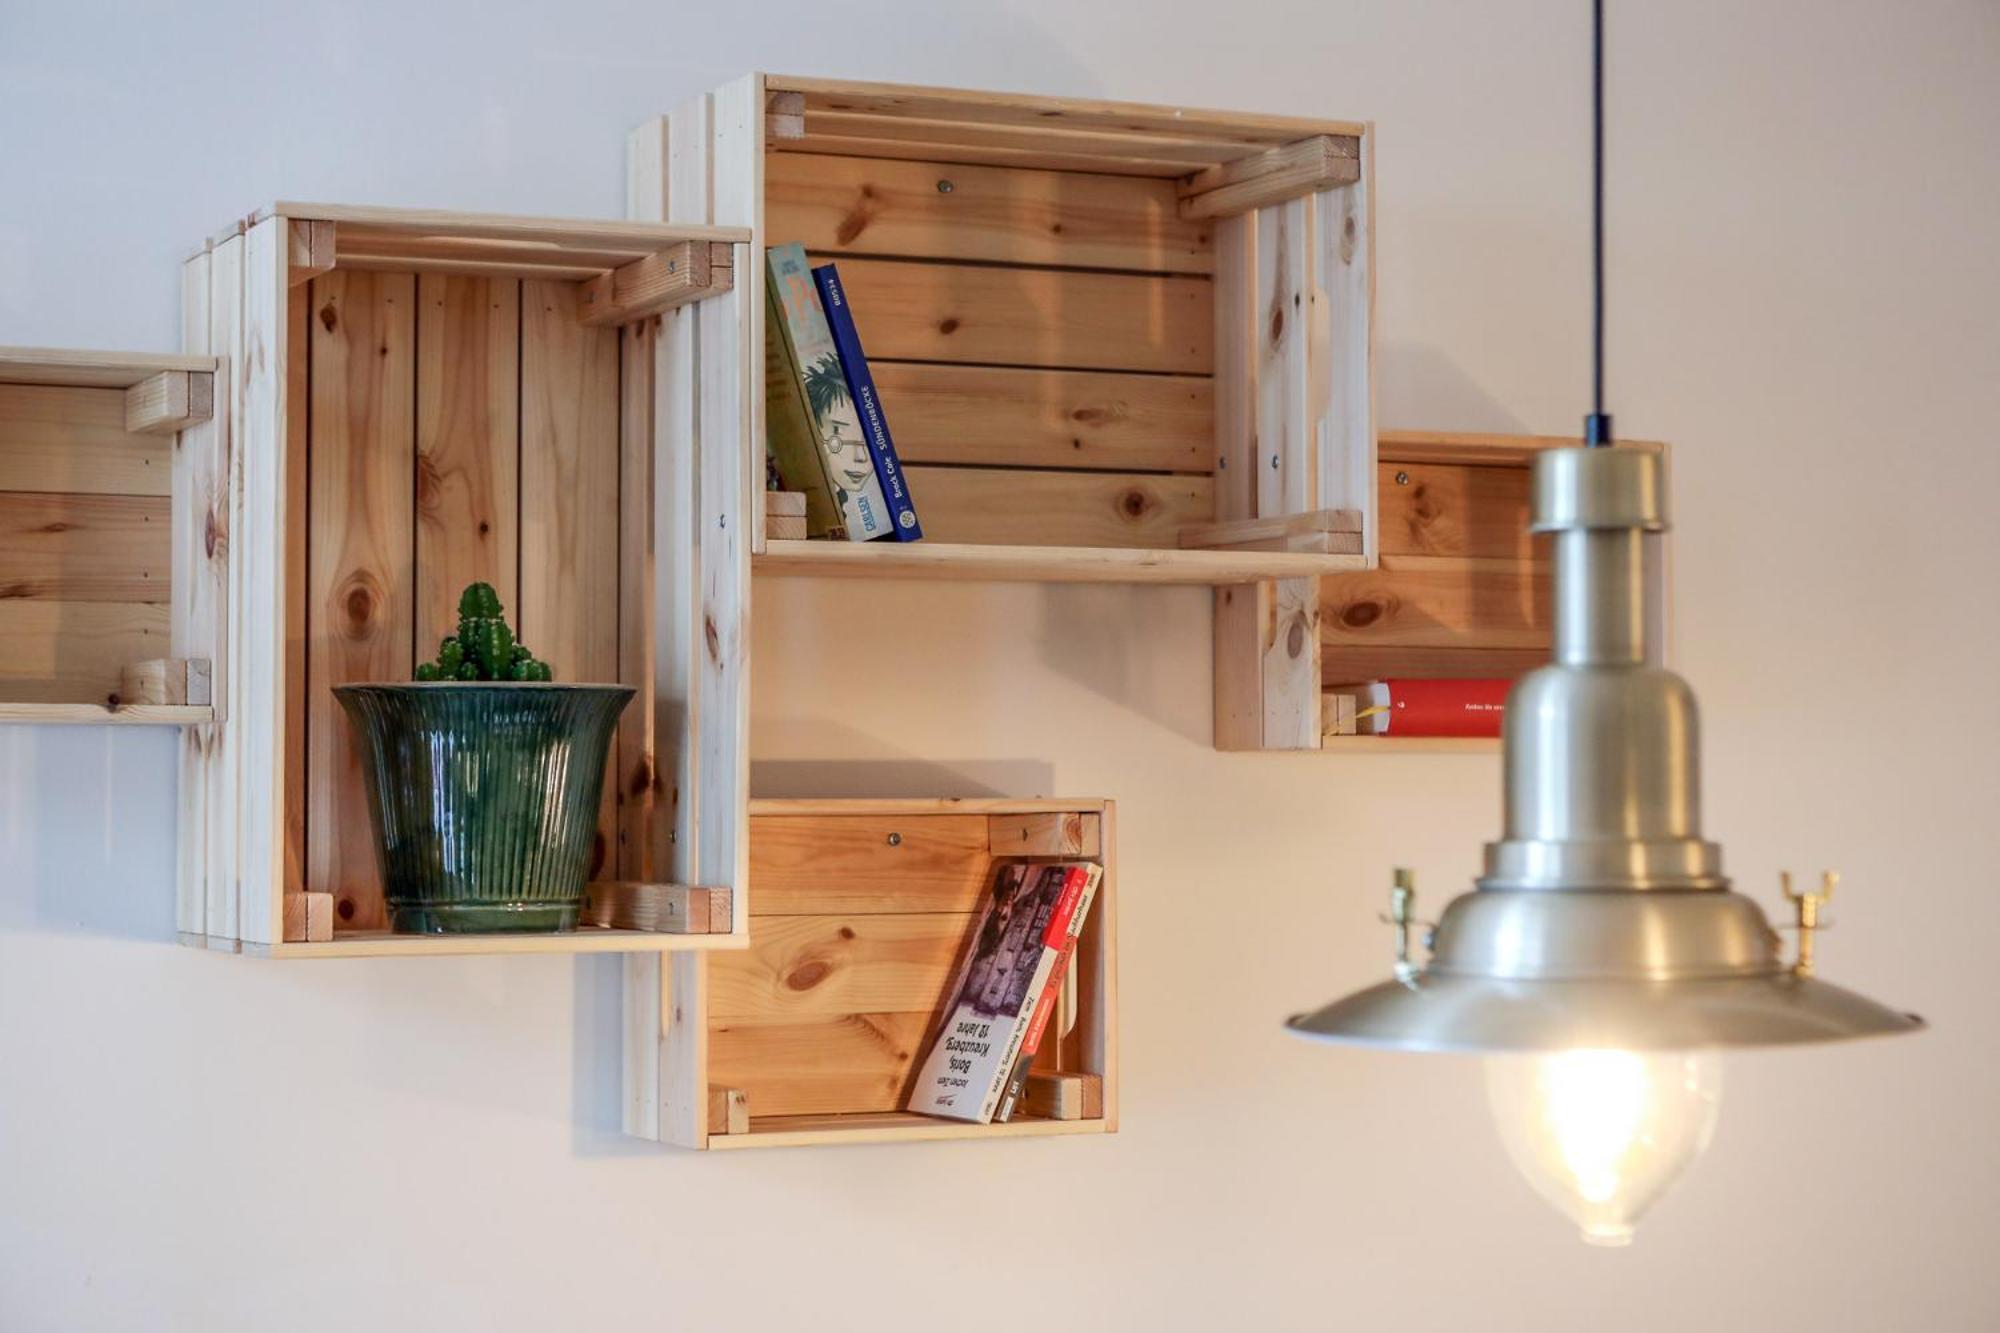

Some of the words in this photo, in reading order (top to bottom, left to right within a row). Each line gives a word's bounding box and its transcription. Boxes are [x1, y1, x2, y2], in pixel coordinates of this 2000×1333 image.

[861, 385, 888, 451] SÜNDENBÖCKE
[957, 1022, 980, 1037] Jahre
[978, 1024, 990, 1038] 12
